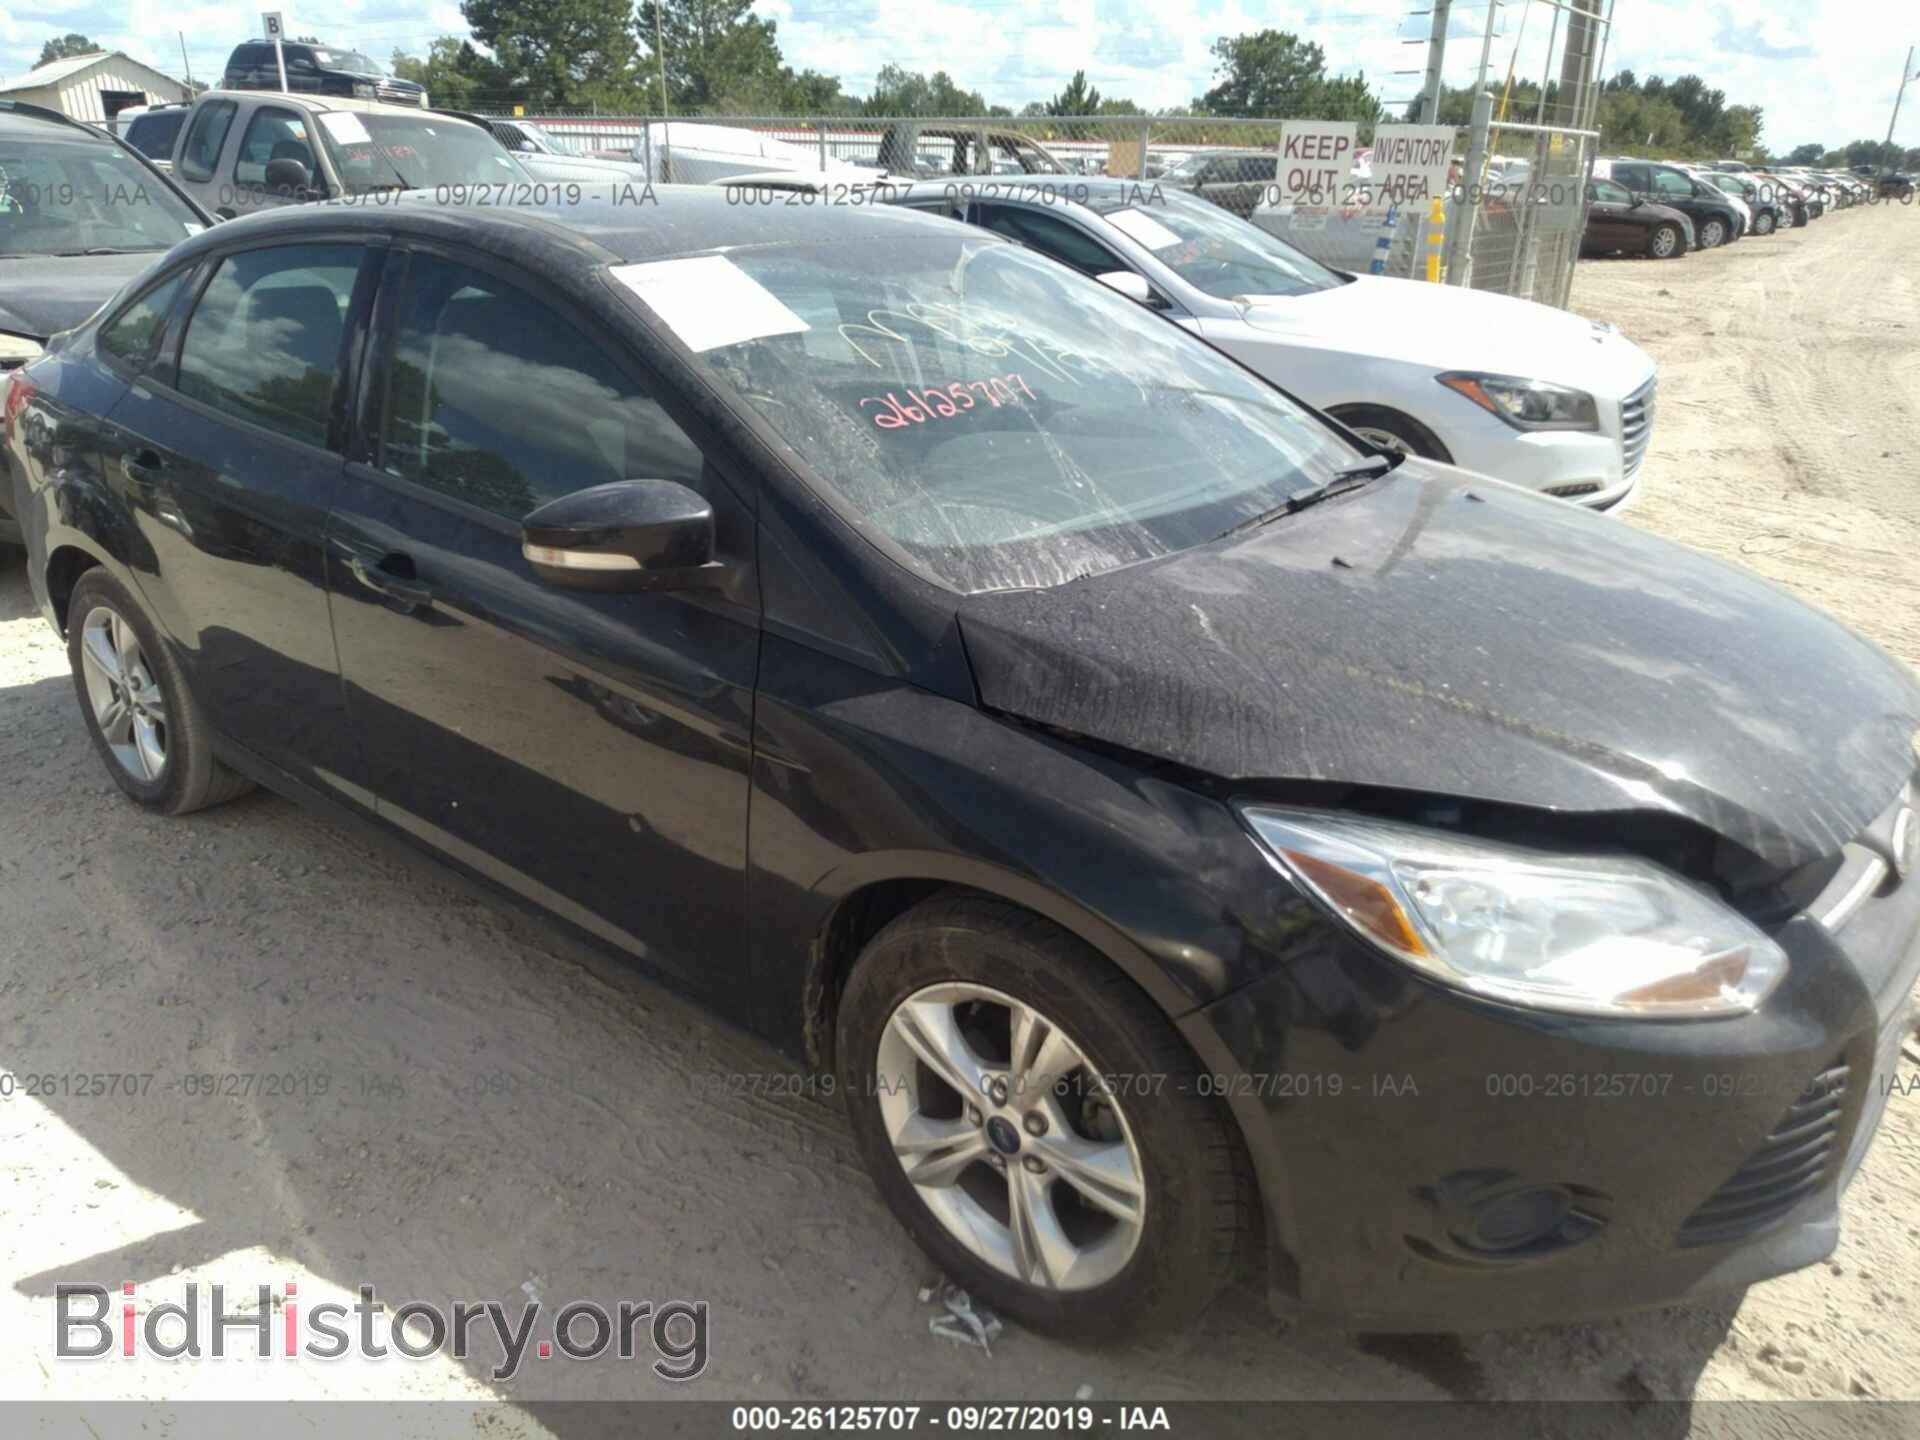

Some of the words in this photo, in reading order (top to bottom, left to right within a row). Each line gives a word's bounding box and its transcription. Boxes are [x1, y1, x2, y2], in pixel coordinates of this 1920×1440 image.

[267, 16, 280, 34] B
[1283, 134, 1349, 161] KEEP
[1374, 136, 1451, 167] INVENTORY
[1287, 168, 1339, 193] OUT
[1379, 173, 1430, 201] AREA
